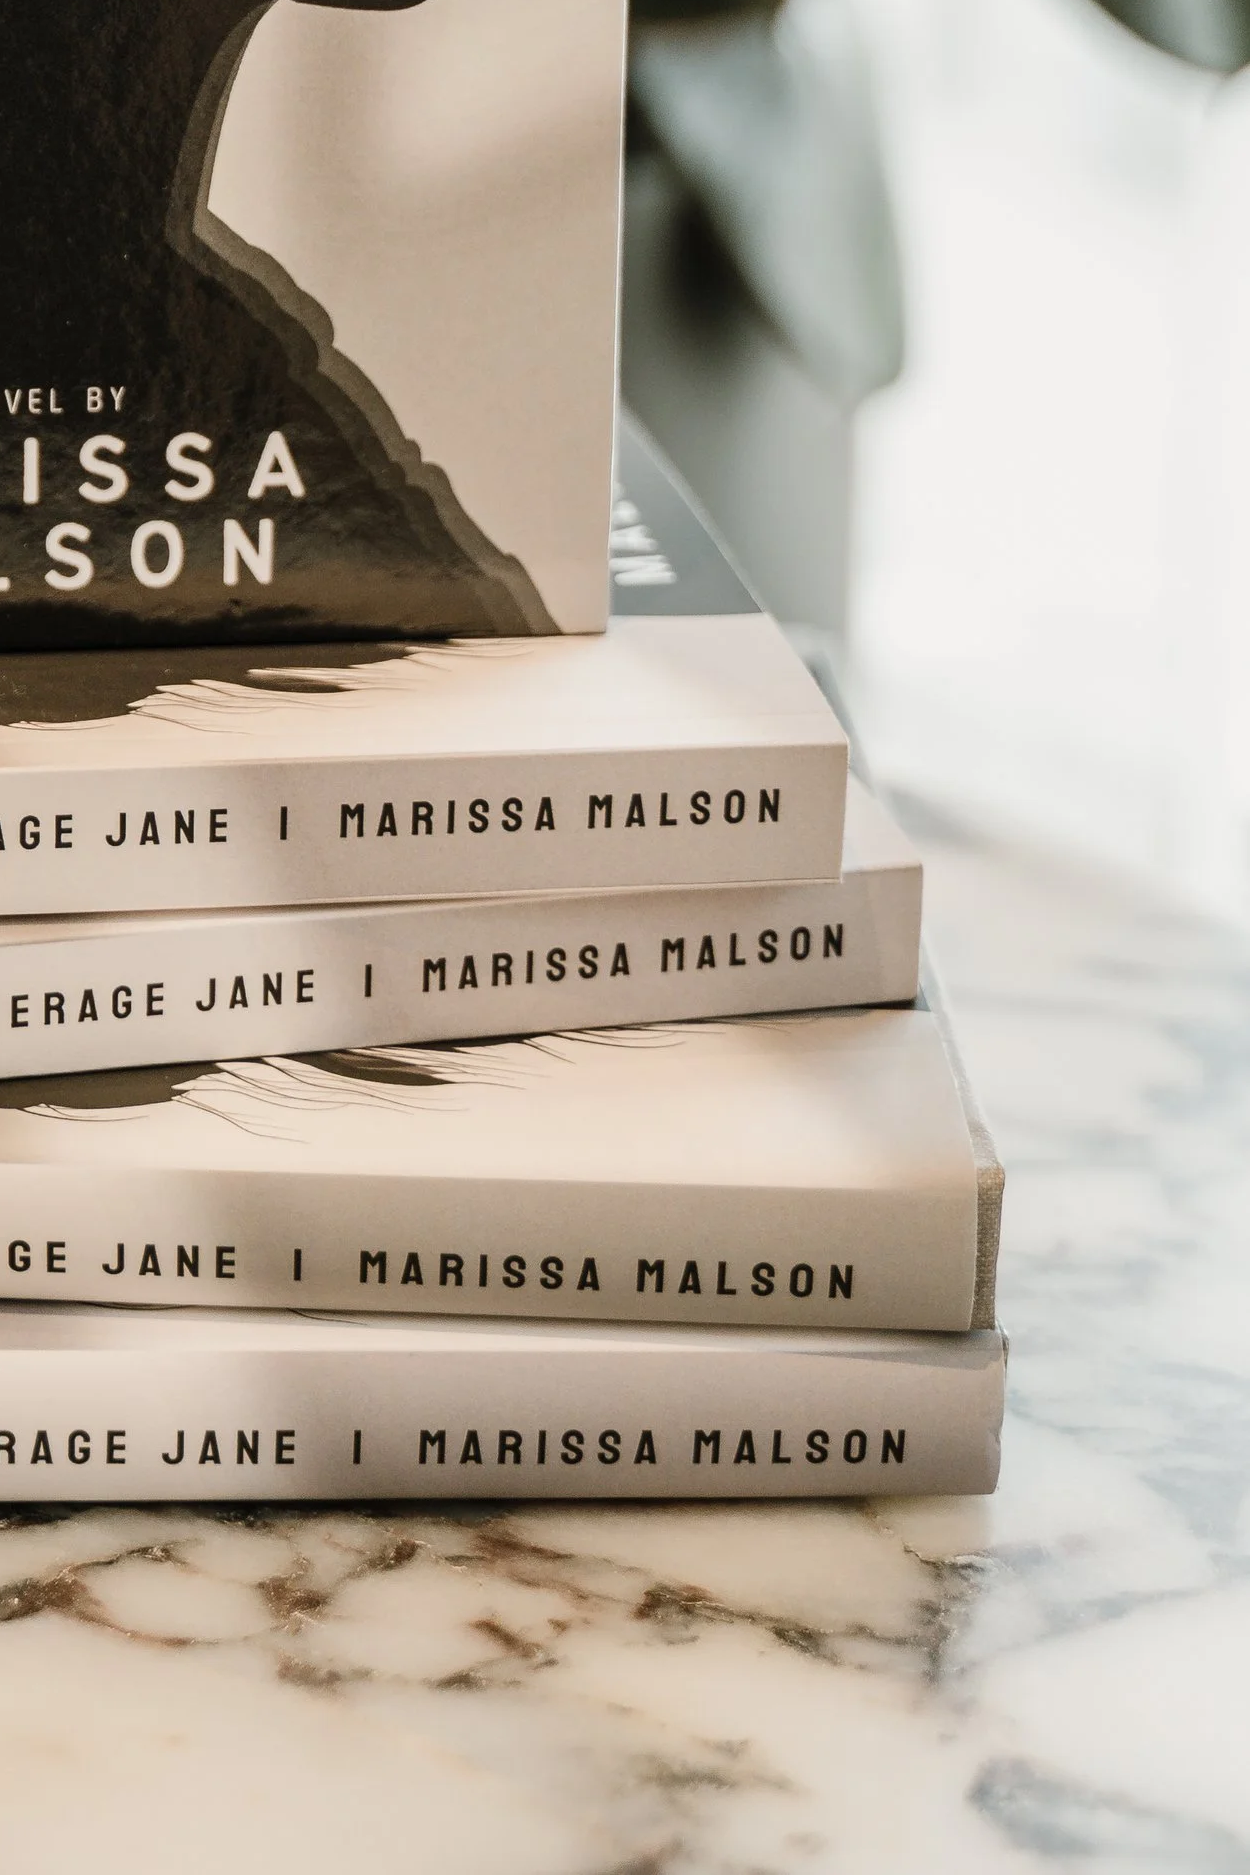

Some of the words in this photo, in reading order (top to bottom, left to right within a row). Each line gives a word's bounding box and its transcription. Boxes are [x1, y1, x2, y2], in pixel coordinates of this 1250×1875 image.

[87, 386, 124, 413] BY
[104, 807, 228, 847] JANE
[339, 796, 556, 839] MARISSA
[587, 787, 781, 830] MALSON
[195, 968, 315, 1012] JANE
[421, 942, 631, 993] MARISSA
[660, 922, 844, 973] MALSON
[101, 1242, 236, 1280] JANE
[359, 1249, 601, 1292] MARISSA
[635, 1258, 854, 1300] MALSON
[161, 1429, 296, 1465] JANE
[418, 1428, 657, 1465] MARISSA
[692, 1428, 907, 1465] MALSON
